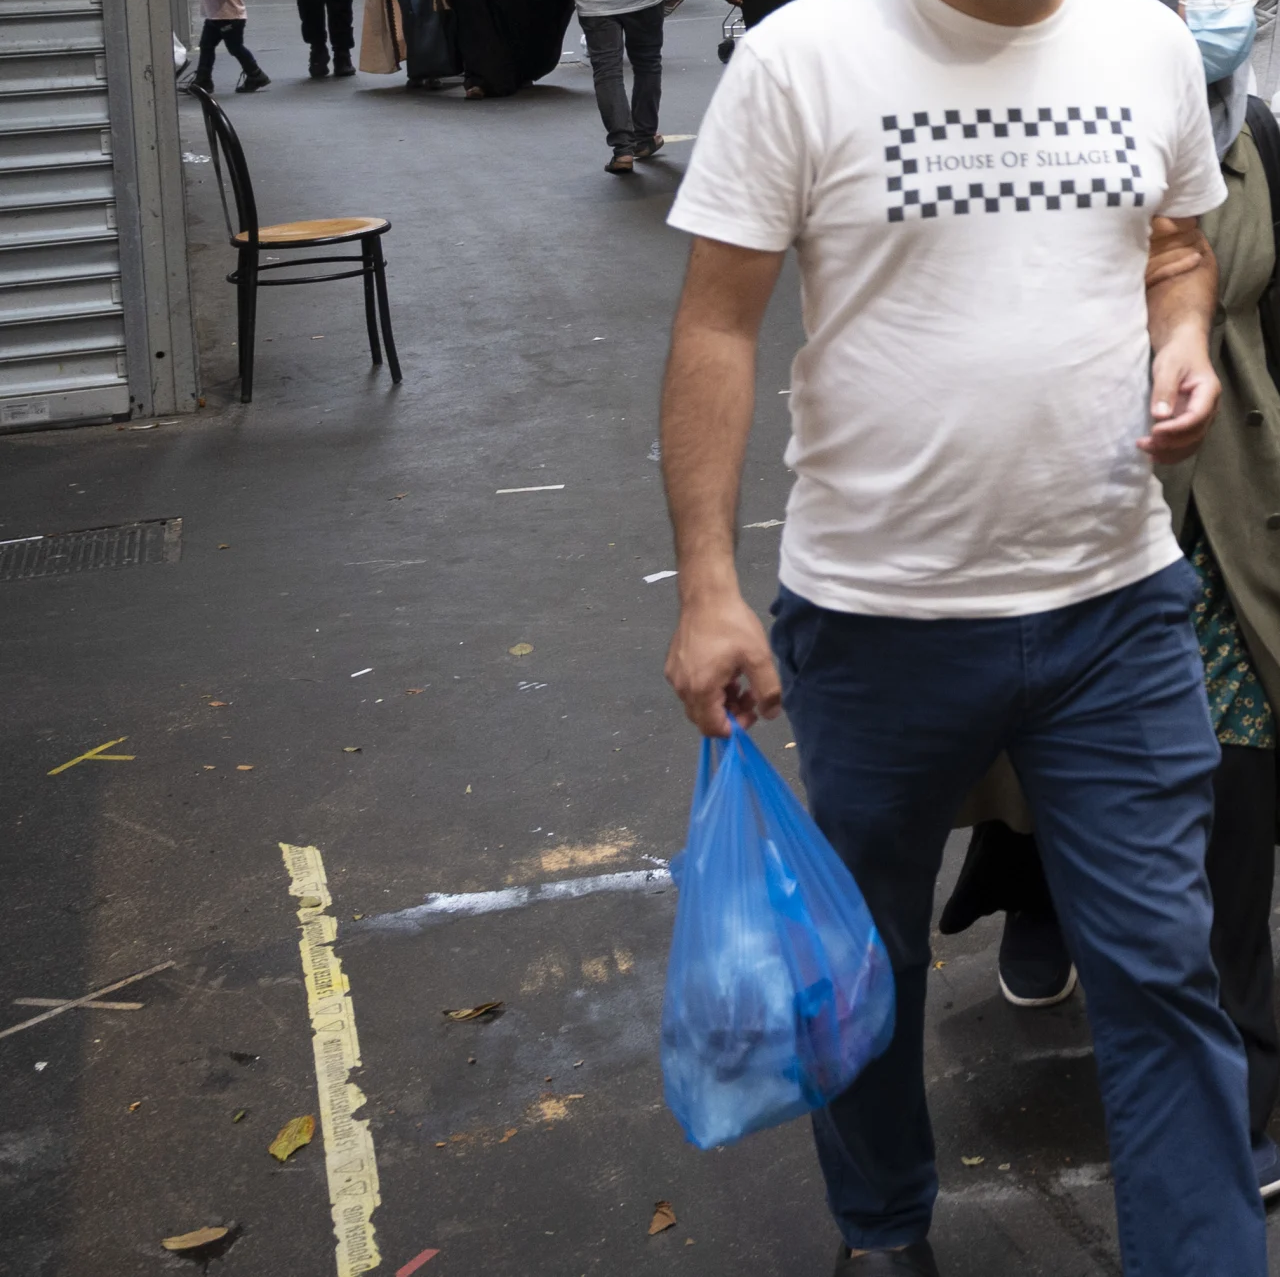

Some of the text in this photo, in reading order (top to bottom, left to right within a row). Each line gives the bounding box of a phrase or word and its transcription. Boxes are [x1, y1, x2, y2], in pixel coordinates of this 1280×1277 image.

[925, 149, 1113, 173] HOUSE OF SILLAGE
